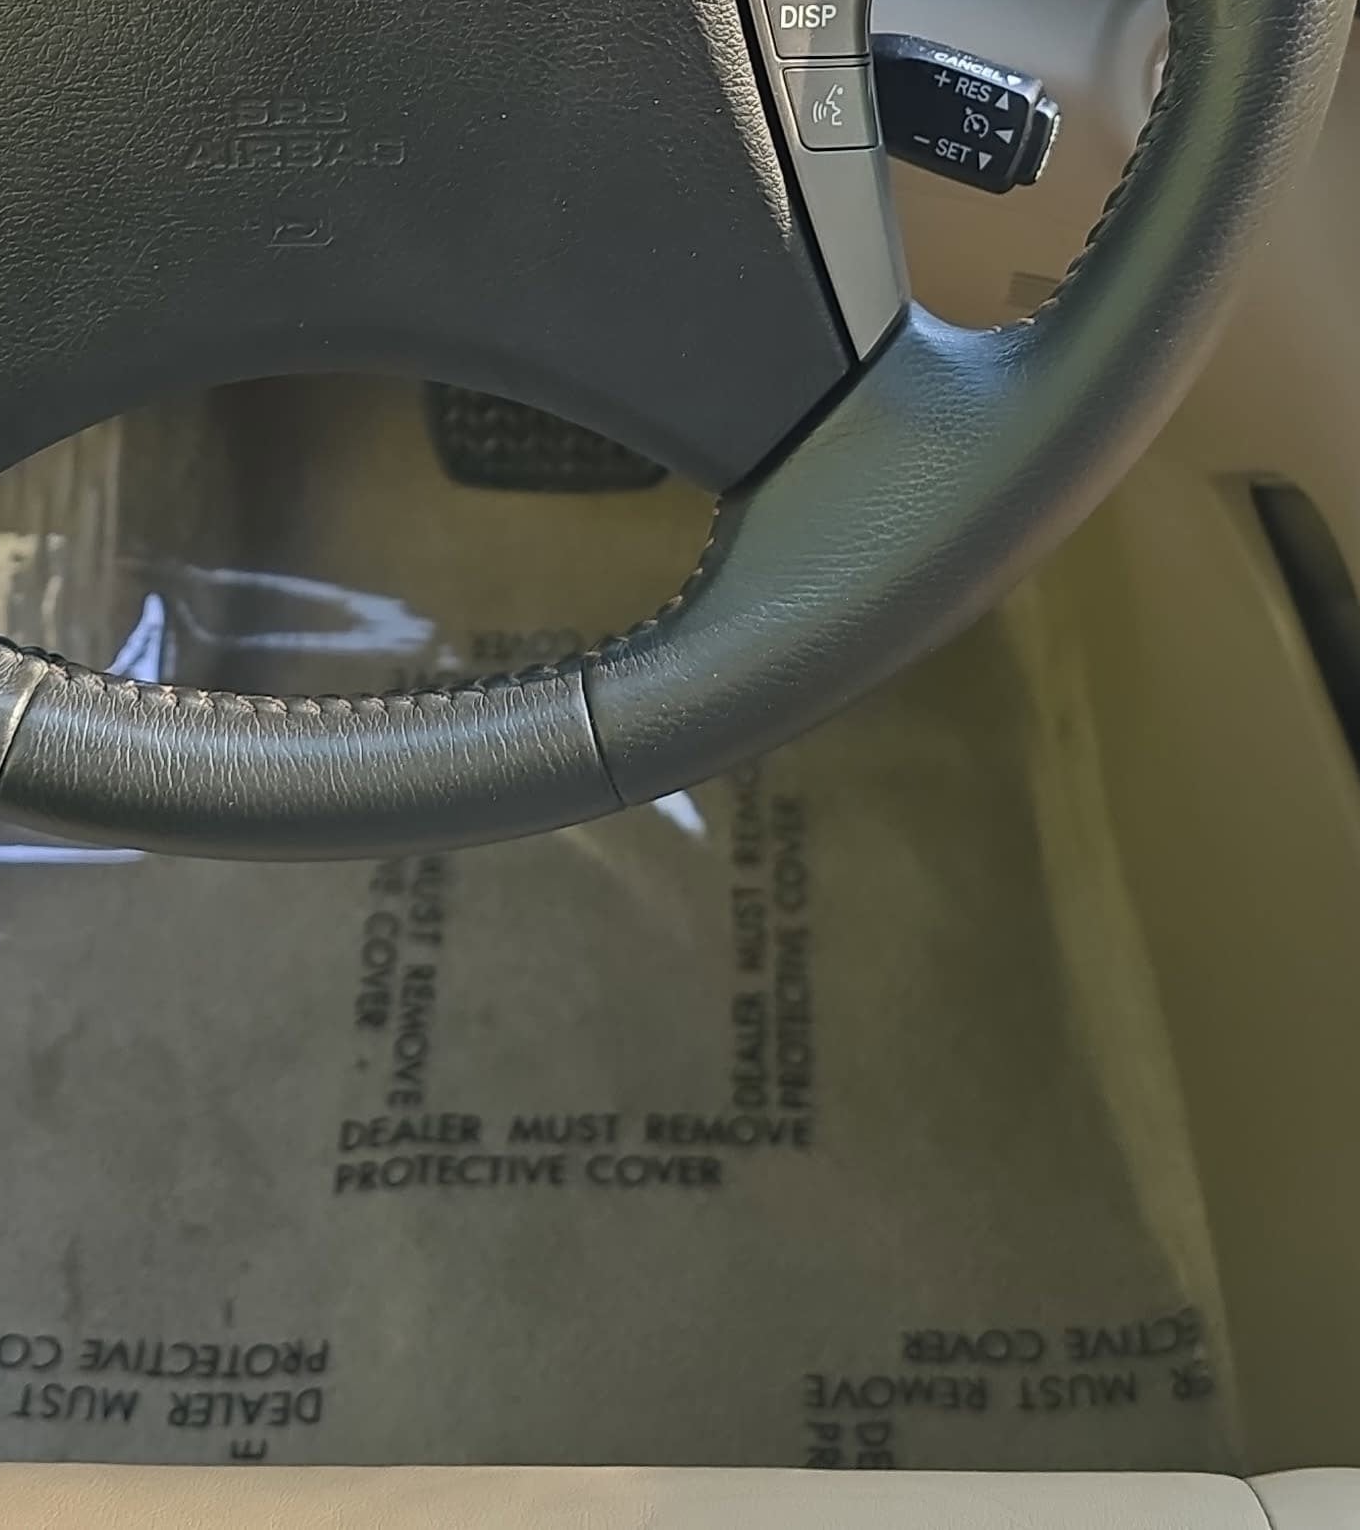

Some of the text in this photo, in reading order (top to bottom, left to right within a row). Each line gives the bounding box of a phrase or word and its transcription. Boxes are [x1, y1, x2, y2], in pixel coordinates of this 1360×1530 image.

[780, 5, 837, 29] DISP
[934, 52, 1003, 81] CANCEL
[955, 77, 992, 103] RES
[935, 139, 972, 164] SET
[354, 911, 401, 1030] COVER
[387, 963, 439, 1108] REMOVE
[338, 1111, 815, 1153] DEALER MUST REMOVE
[334, 1154, 722, 1196] PROTECTIVE COVER
[80, 1336, 330, 1381] PROTECTIVE
[901, 1328, 1047, 1363] COVER
[12, 1382, 137, 1423] MUST
[167, 1386, 324, 1430] DEALER
[803, 1373, 990, 1413] REMOVE
[1019, 1370, 1137, 1411] MUST
